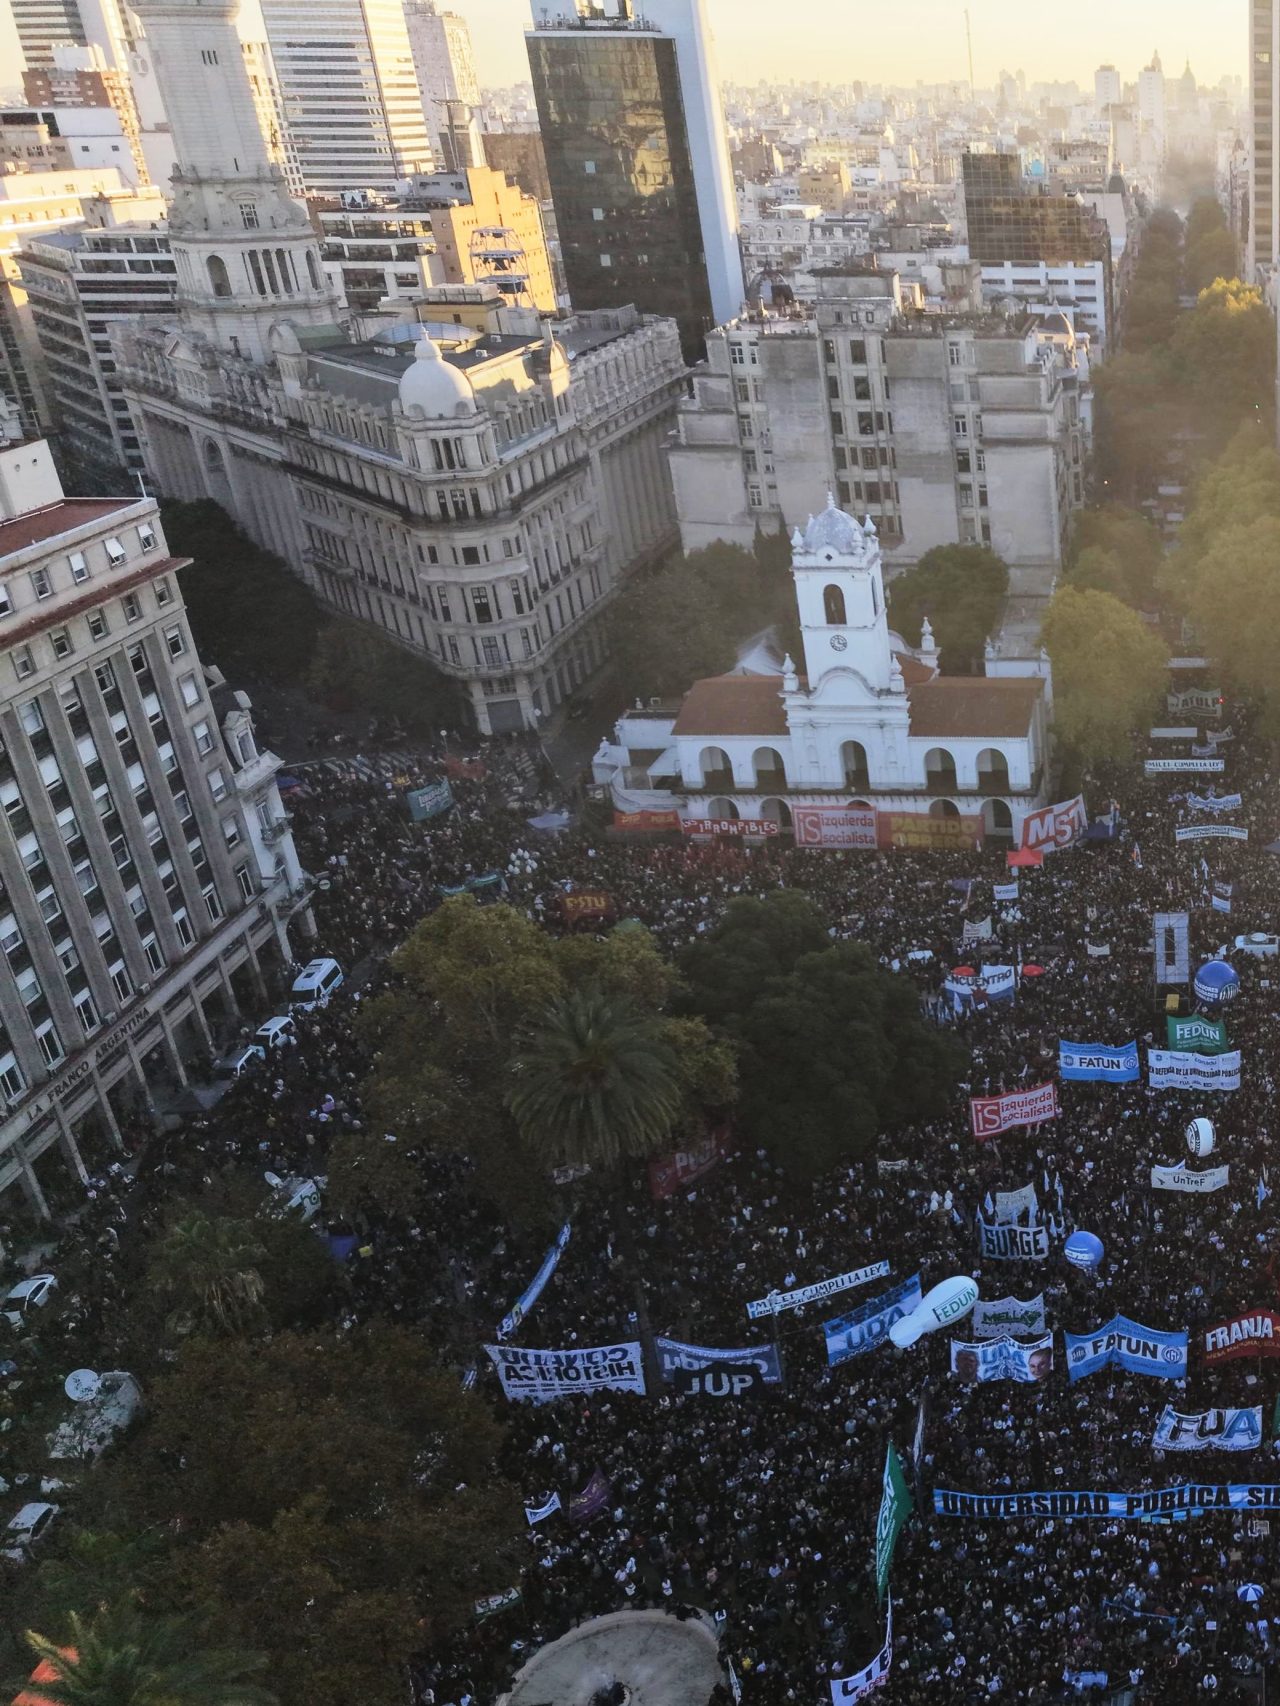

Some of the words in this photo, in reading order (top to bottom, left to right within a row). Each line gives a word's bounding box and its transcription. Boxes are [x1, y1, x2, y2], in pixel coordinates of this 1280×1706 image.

[700, 819, 778, 835] IRROMPIBLES
[820, 814, 874, 830] izquierda
[890, 816, 978, 833] PARTIDO
[822, 830, 876, 845] socialista
[891, 834, 974, 848] OBRERO
[1176, 1022, 1220, 1040] FEDUN
[27, 1103, 44, 1121] LA
[47, 1060, 90, 1102] FRANCO
[95, 1007, 150, 1061] ARGENTINA
[1079, 1057, 1121, 1070] FATUN
[1175, 1067, 1182, 1075] DE
[1000, 1090, 1053, 1112] izquierda
[1002, 1102, 1055, 1125] socialista
[984, 1228, 1046, 1257] SURGE
[802, 1278, 846, 1297] CUMPLI
[848, 1272, 861, 1284] LA
[864, 1264, 882, 1278] LEY
[932, 1287, 976, 1322] FEDUN
[845, 1305, 906, 1350] UDA
[1205, 1315, 1274, 1352] FRANJA
[1091, 1333, 1158, 1360] FATUN
[684, 1372, 754, 1396] JUP
[1168, 1408, 1261, 1441] FUA
[942, 1491, 1110, 1517] UNIVERSIDAD
